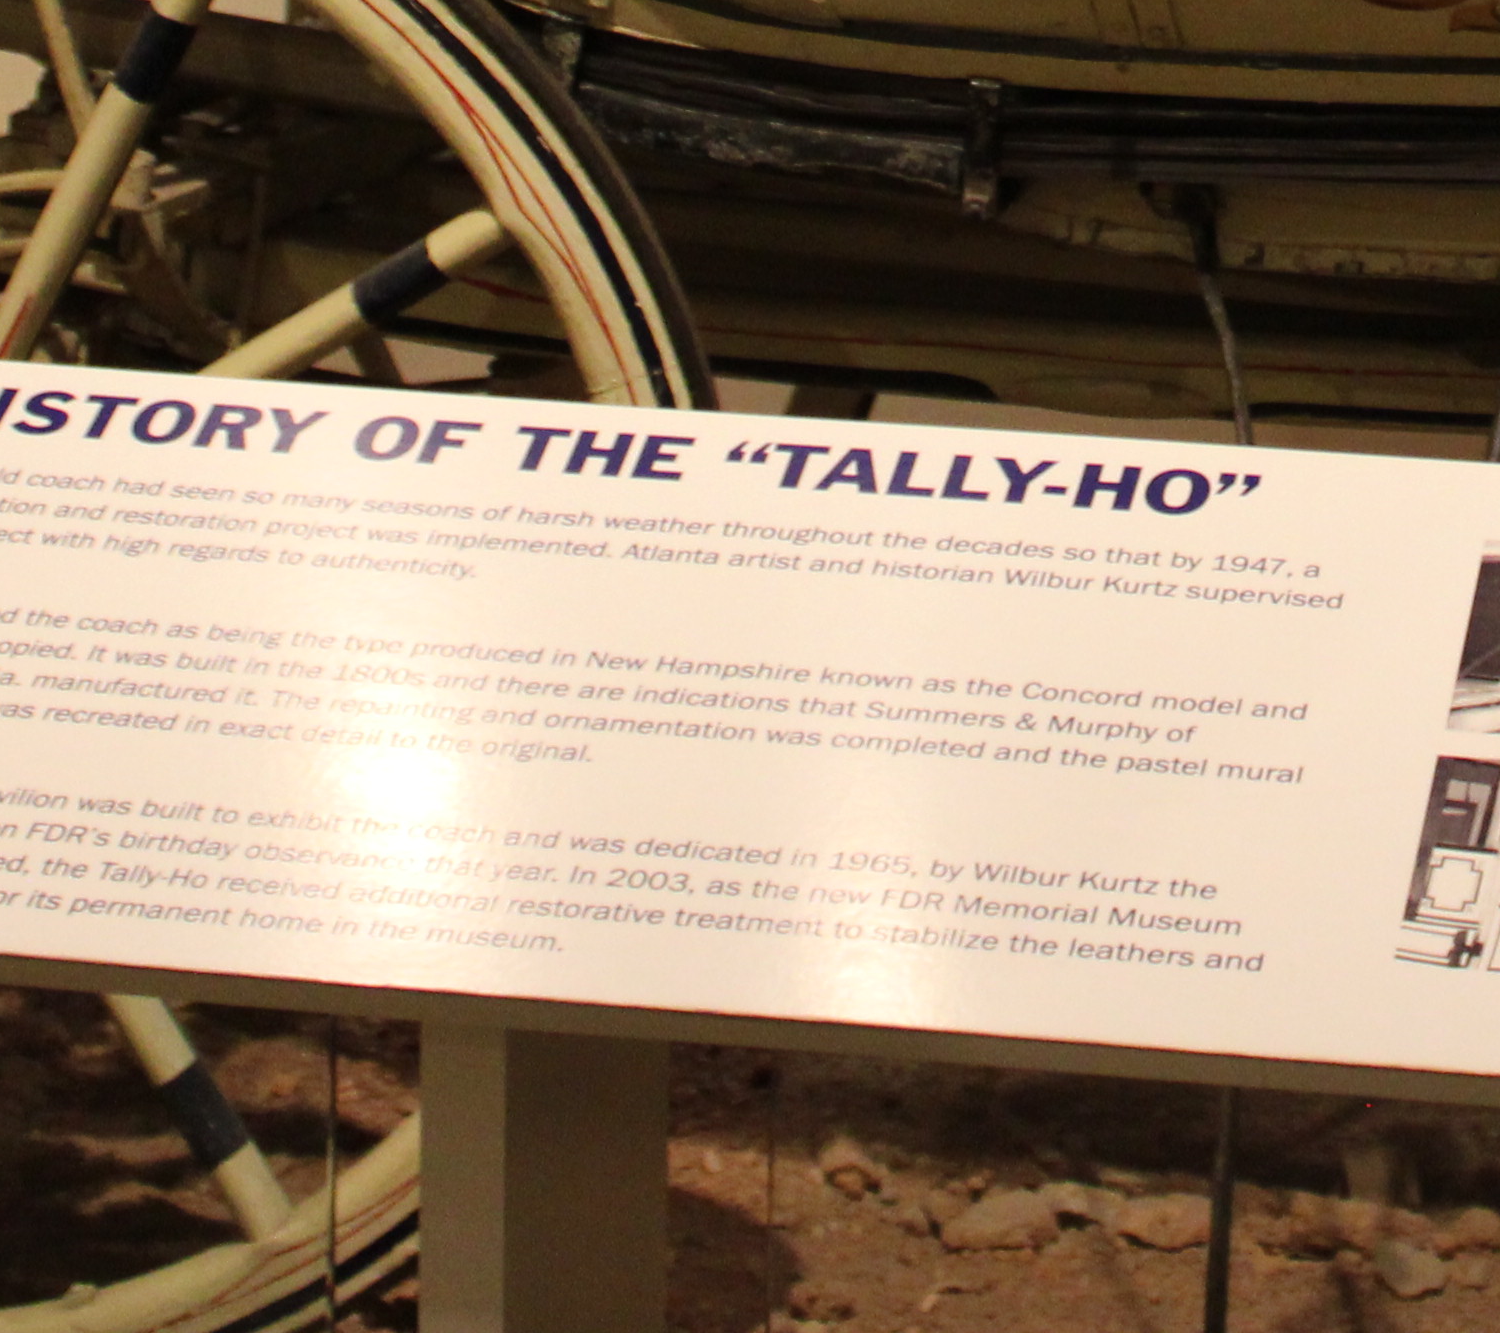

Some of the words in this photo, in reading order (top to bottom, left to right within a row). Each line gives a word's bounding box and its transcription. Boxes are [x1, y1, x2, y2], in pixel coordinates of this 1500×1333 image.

[353, 415, 483, 464] OF
[520, 427, 693, 480] THE
[25, 471, 108, 492] coach
[111, 475, 167, 497] had
[168, 482, 238, 501] seen
[241, 488, 279, 505] so
[280, 491, 360, 514] many
[360, 497, 476, 520] seasons
[480, 502, 515, 522] of
[516, 506, 596, 528] harsh
[603, 514, 715, 535] weather
[721, 519, 875, 547] throughout
[881, 529, 928, 550] the
[934, 533, 1055, 559] decades
[1061, 544, 1098, 562] so
[1104, 545, 1162, 568] that
[1169, 548, 1203, 573] by
[1211, 552, 1293, 579] 1947,
[1301, 562, 1321, 578] a
[40, 530, 98, 549] with
[102, 532, 162, 558] high
[166, 539, 273, 564] regards
[276, 546, 308, 566] to
[310, 551, 476, 582] authenticity.
[52, 502, 110, 522] and
[111, 507, 259, 532] restoration
[261, 517, 362, 542] project
[366, 526, 421, 545] was
[427, 531, 612, 559] implemented.
[621, 540, 721, 565] Atlanta
[726, 550, 802, 571] artist
[807, 556, 866, 575] and
[871, 557, 995, 584] historian
[1003, 566, 1095, 591] Wilbur
[1101, 574, 1179, 598] Kurtz
[1185, 583, 1345, 610] supervised
[25, 887, 65, 911] its
[66, 895, 234, 926] permanent
[237, 905, 325, 934] home
[329, 913, 362, 937] in
[367, 916, 421, 941] the
[425, 920, 564, 953] museum.
